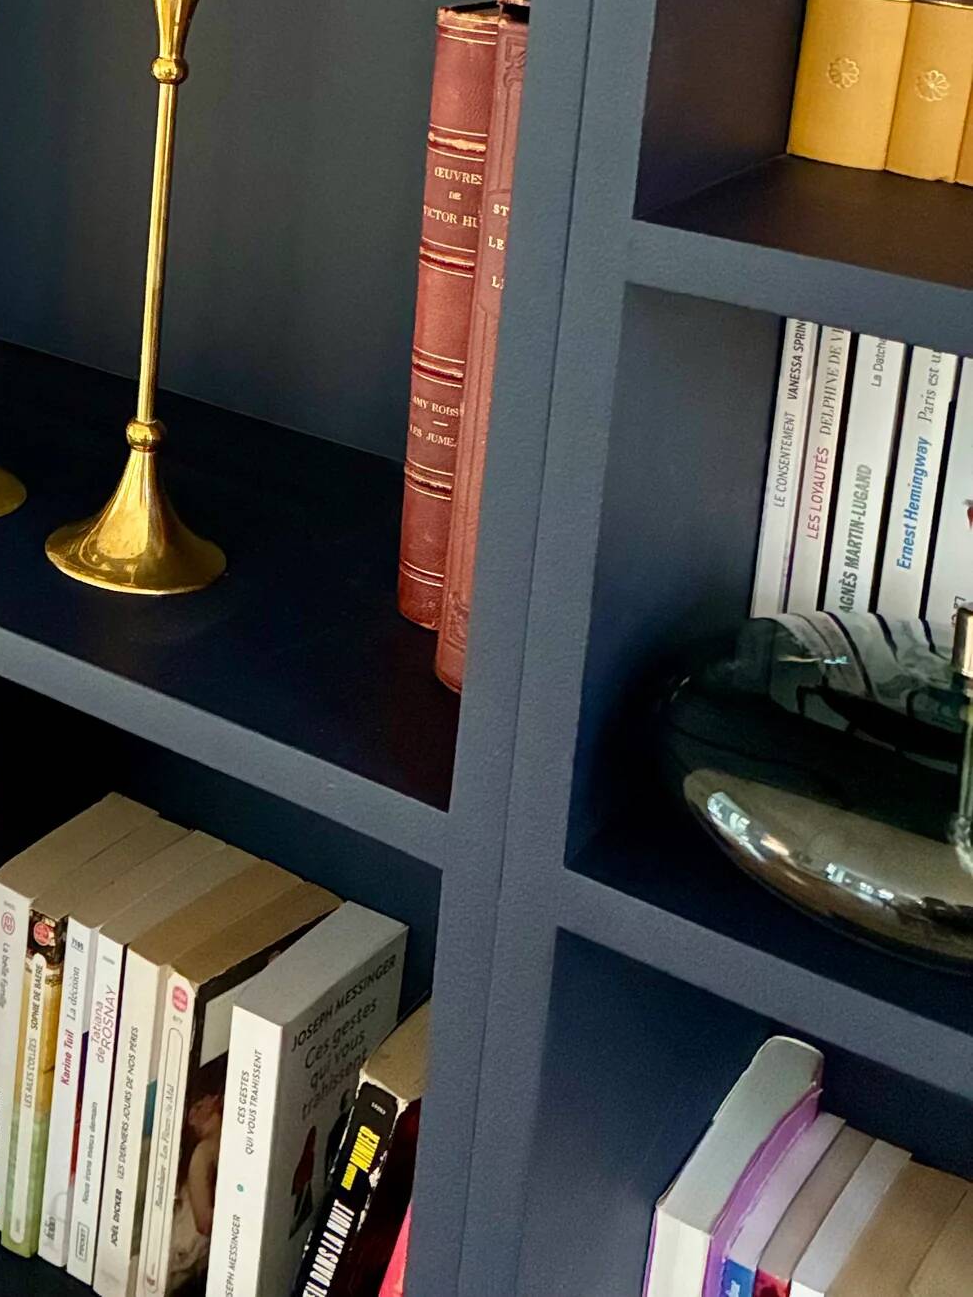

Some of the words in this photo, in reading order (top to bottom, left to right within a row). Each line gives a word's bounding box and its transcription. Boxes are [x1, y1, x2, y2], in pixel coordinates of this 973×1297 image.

[827, 346, 842, 368] DE
[787, 354, 805, 401] VANESSA
[871, 371, 882, 387] La
[927, 369, 940, 388] est
[819, 368, 839, 436] DELPHINE
[917, 389, 937, 424] Paris
[776, 411, 796, 493] CONSENTEMENT
[810, 446, 830, 512] LOYAUTÉS
[903, 436, 933, 521] Hemingway
[773, 493, 785, 508] LE
[844, 464, 873, 571] MARTIN-LUGAND
[806, 513, 821, 541] LES
[896, 520, 918, 571] Ernest
[838, 572, 858, 614] AGNÈS
[3, 941, 10, 956] La
[34, 963, 44, 986] BAERE
[68, 966, 80, 1008] décision
[33, 989, 41, 1001] DE
[291, 1005, 334, 1052] JOSEPH
[334, 954, 397, 1014] MESSINGER
[31, 1001, 43, 1031] SOPHIE
[66, 1008, 76, 1022] La
[91, 1000, 104, 1044] Tatiana
[95, 1047, 105, 1064] de
[101, 985, 116, 1050] ROSNAY
[63, 1029, 74, 1050] Tuil
[129, 1026, 139, 1051] PÈRES
[305, 1038, 329, 1069] Ces
[332, 998, 377, 1049] gestes
[61, 1050, 72, 1085] Karine
[128, 1053, 136, 1074] NOS
[250, 1049, 263, 1107] TRAHISSENT
[126, 1075, 134, 1088] DE
[239, 1070, 250, 1106] GESTES
[24, 1093, 33, 1109] LES
[122, 1092, 132, 1121] JOURS
[237, 1107, 248, 1125] CES
[247, 1107, 258, 1136] VOUS
[118, 1121, 130, 1165] DERNIERS
[245, 1137, 254, 1155] QUI
[117, 1165, 125, 1180] LES
[112, 1188, 123, 1223] DICKER
[326, 1199, 355, 1234] NUIT
[229, 1214, 242, 1271] MESSINGER
[320, 1231, 346, 1256] LA
[309, 1246, 339, 1288] DANS
